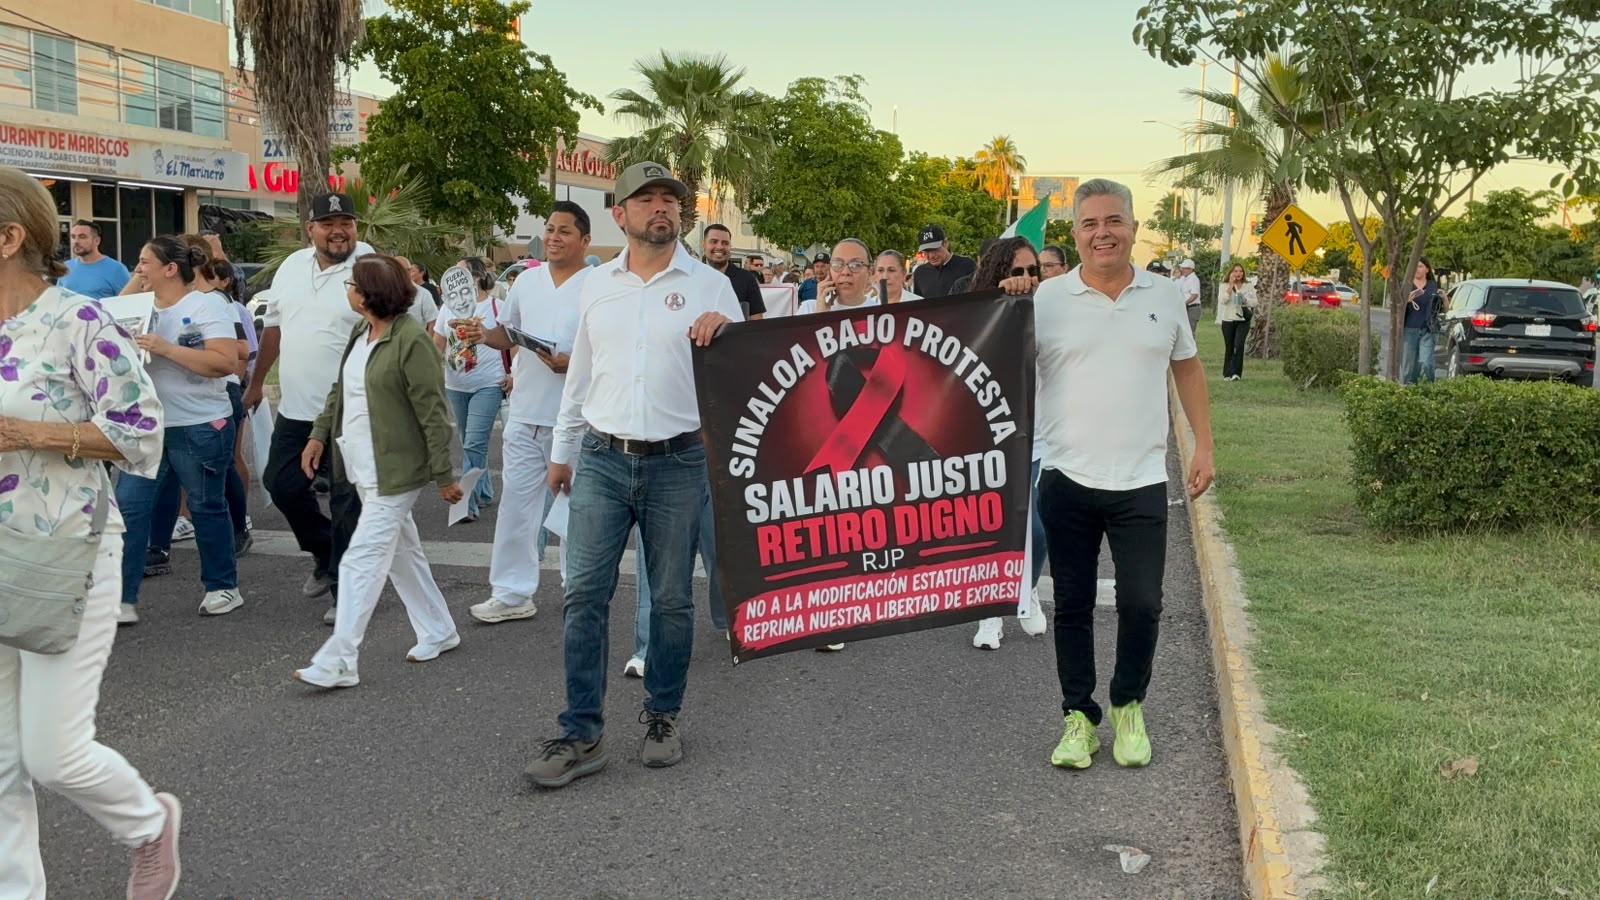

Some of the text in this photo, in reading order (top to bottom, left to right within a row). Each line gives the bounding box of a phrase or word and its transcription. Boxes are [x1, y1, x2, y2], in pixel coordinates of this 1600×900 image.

[0, 125, 129, 158] URANT DE MARISCOS
[35, 150, 77, 163] PALADARES
[166, 160, 225, 180] El Marinero
[446, 271, 464, 285] FUERA
[448, 276, 468, 291] OLIVOS
[729, 313, 1017, 478] SINALOA BAJO PROTESTA
[744, 450, 1007, 523] SALARIO JUSTO
[757, 491, 1004, 567] RETIRO DIGNO
[862, 548, 905, 572] RJP
[746, 598, 766, 619] NO
[770, 597, 780, 616] A
[785, 595, 802, 612] LA
[808, 572, 907, 607] MODIFICACIÓN
[912, 560, 999, 592] ESTATUTARIA
[743, 581, 1020, 644] REPRIMA NUESTRA LIBERTAD DE EXPRESI
